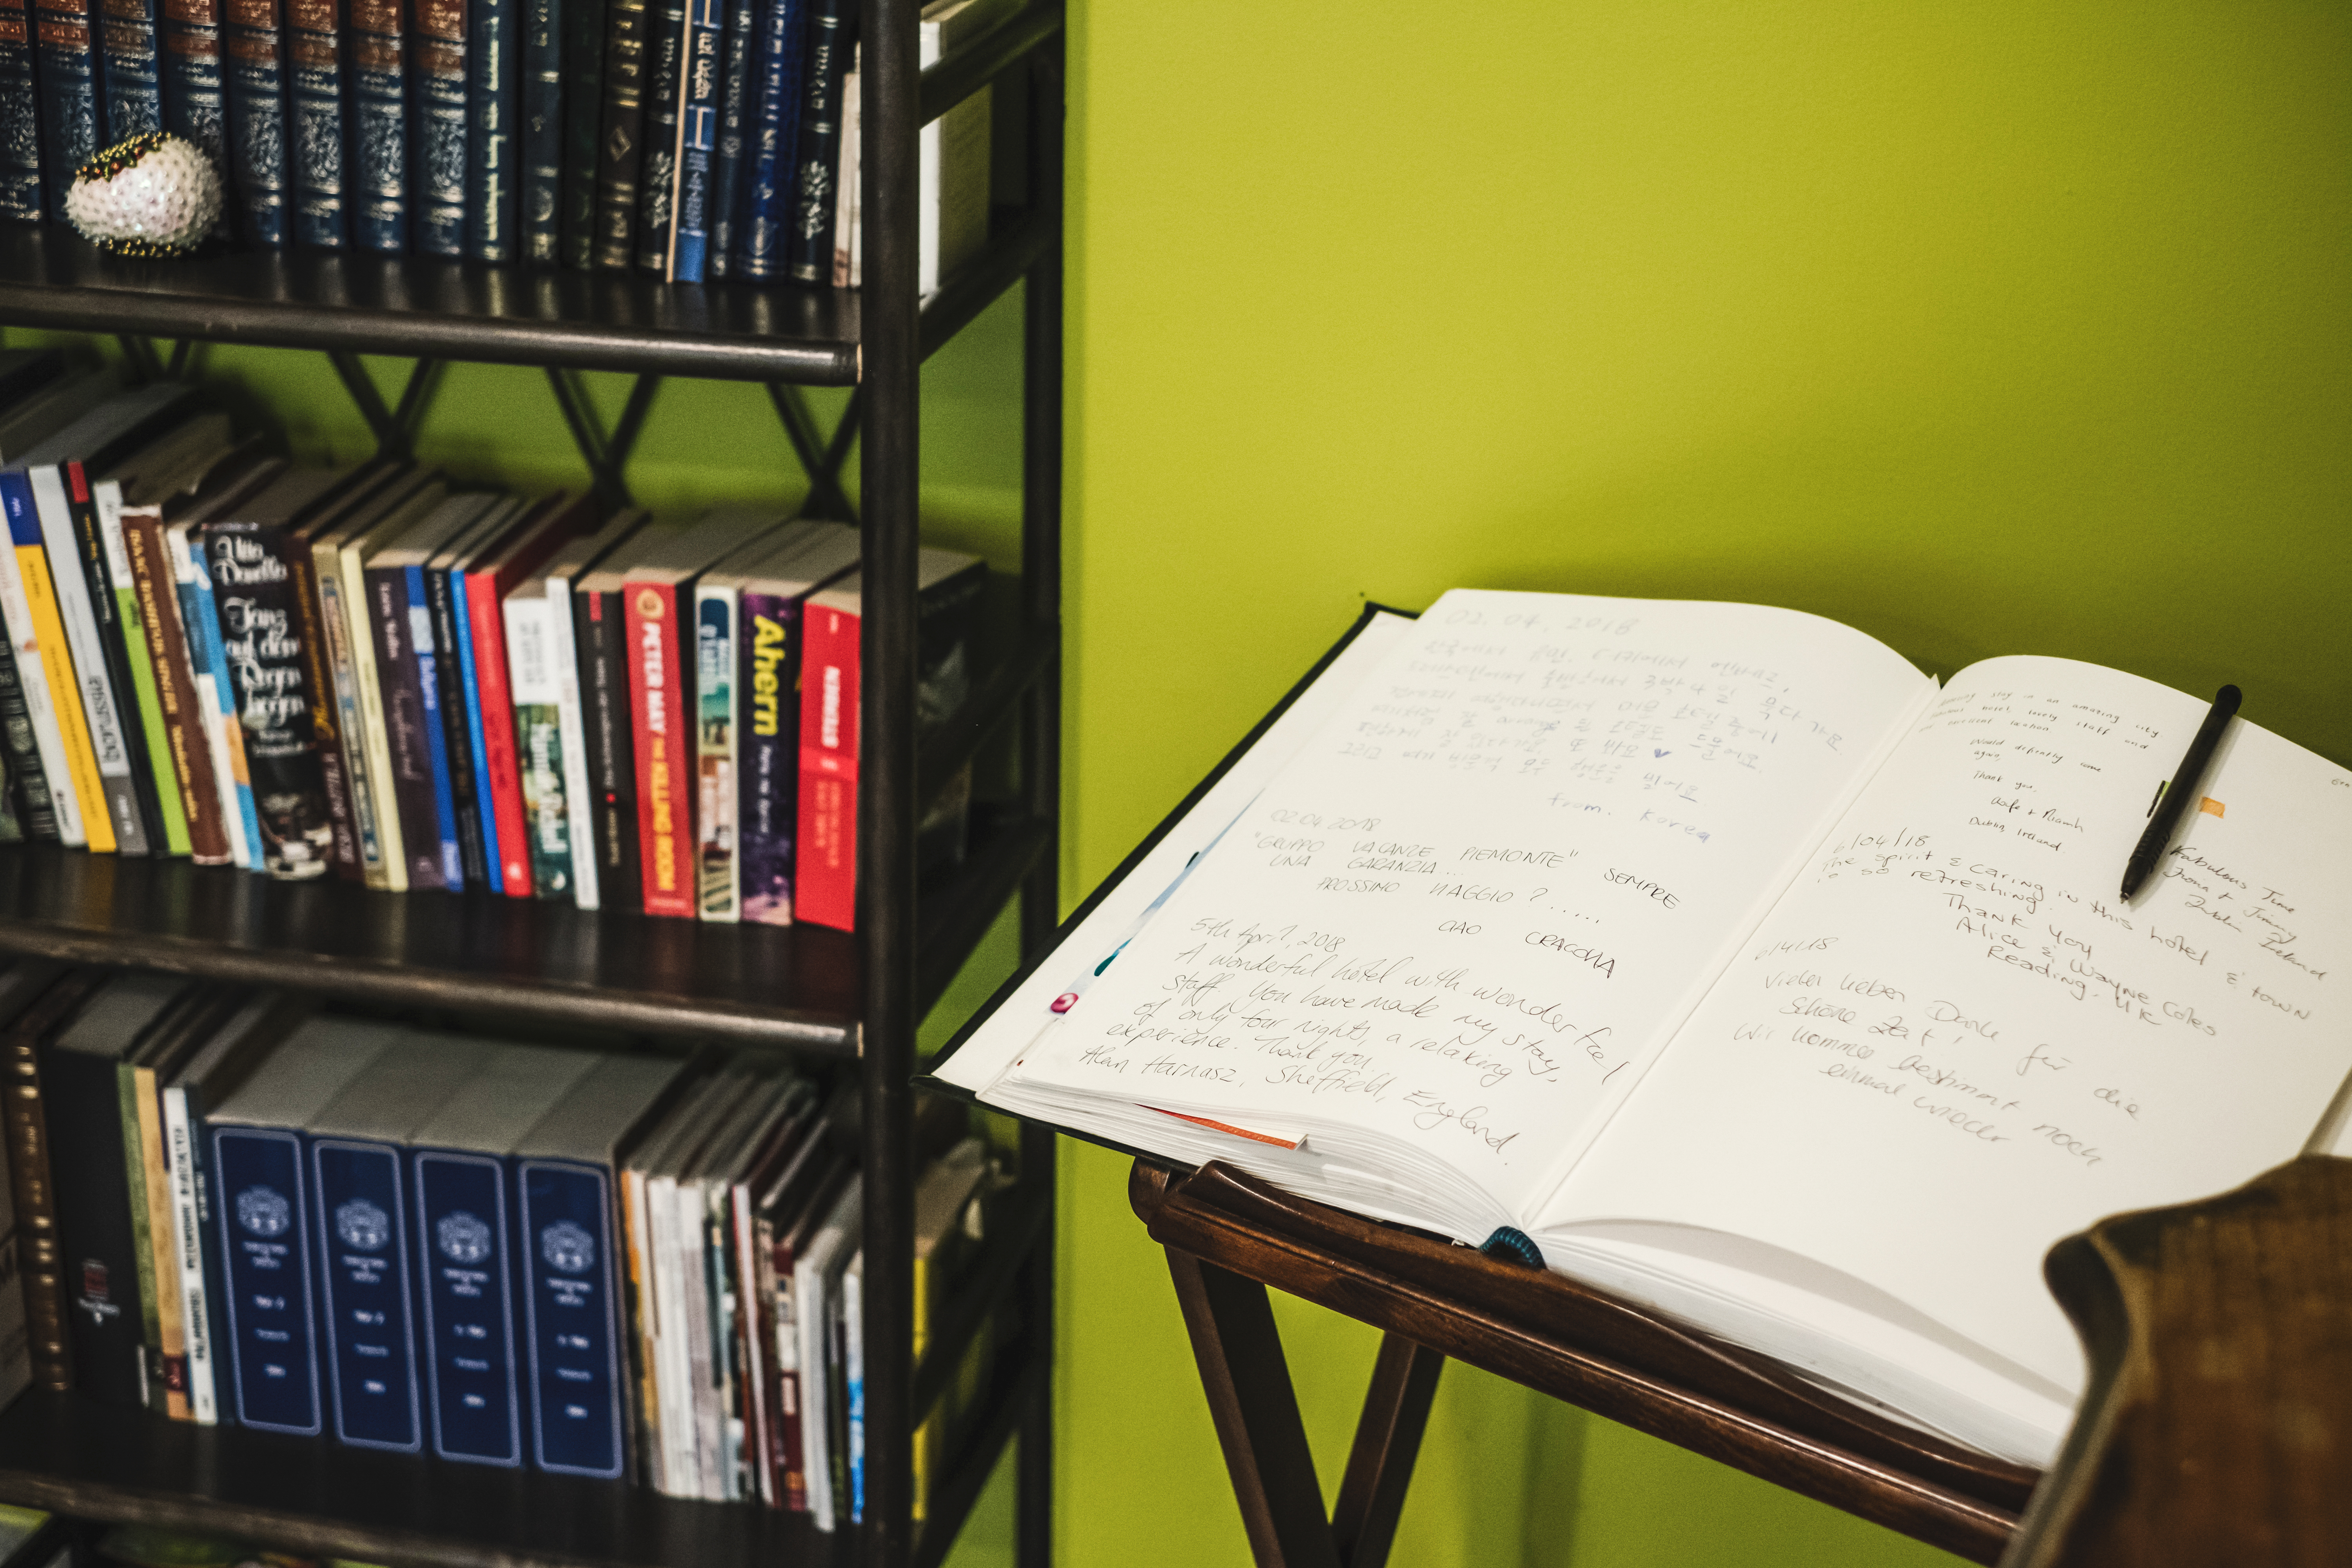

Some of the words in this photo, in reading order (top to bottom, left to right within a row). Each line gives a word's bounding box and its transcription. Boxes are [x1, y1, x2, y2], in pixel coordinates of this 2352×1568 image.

[1566, 617, 1640, 636] 2018
[641, 622, 664, 688] PETER
[753, 614, 784, 736] Ahern
[647, 689, 666, 733] MAY
[1495, 715, 1561, 738] arrange
[1947, 717, 1993, 726] excellent
[1990, 691, 2014, 701] stay
[2071, 704, 2121, 724] amazing
[2027, 709, 2058, 722] lovely
[2076, 721, 2111, 736] staff
[2124, 739, 2150, 750] and
[1973, 769, 2004, 783] Thank
[2079, 761, 2102, 773] come
[650, 761, 673, 833] KILLING
[1639, 808, 1712, 844] Korea
[2041, 808, 2084, 833] Niamh
[1832, 826, 1931, 855] 6/04/18
[655, 834, 675, 891] ROOM
[1269, 854, 1312, 867] UNA
[1352, 840, 1436, 858] VACANZE
[1459, 846, 1579, 868] PIEMONTE"
[1603, 867, 1681, 910] SEMPRE
[1860, 867, 1890, 876] so
[2169, 845, 2247, 889] Fabulous
[2261, 886, 2295, 914] Time
[1316, 877, 1401, 893] PROSSIMO
[1428, 881, 1514, 903] VIAGGIO
[1941, 892, 2031, 930] Thank
[2184, 894, 2242, 933] Dublin
[1190, 916, 1234, 938] 5th
[1297, 931, 1346, 953] 2018
[1822, 857, 1859, 872] The
[1874, 850, 1933, 868] spirit
[1968, 863, 2045, 902] Caring
[2058, 889, 2079, 904] in
[2089, 900, 2134, 931] this
[2149, 925, 2209, 965] hotel
[2251, 985, 2311, 1020] town
[1174, 942, 1207, 965] A
[1209, 953, 1338, 977] wonderful
[1331, 956, 1414, 984] hotel
[1404, 967, 1470, 992] with
[1524, 931, 1615, 980] CRACOVIA
[1955, 916, 2027, 949] Alice
[2069, 958, 2151, 1005] Wayne
[1229, 980, 1292, 1014] You
[1299, 984, 1357, 1009] have
[1360, 995, 1439, 1018] made
[1452, 1014, 1499, 1047] my
[2115, 996, 2162, 1026] UK
[1133, 997, 1172, 1026] of
[1178, 1002, 1232, 1035] only
[1240, 1007, 1290, 1029] four
[1385, 1032, 1402, 1045] a
[1409, 1036, 1513, 1089] relaxing
[1253, 1035, 1329, 1060] Thank
[1924, 1000, 2001, 1042] Dank
[2092, 1087, 2140, 1122] die
[1733, 1022, 1777, 1041] Wir
[2032, 1123, 2103, 1167] noch
[1818, 1063, 1907, 1097] einmal
